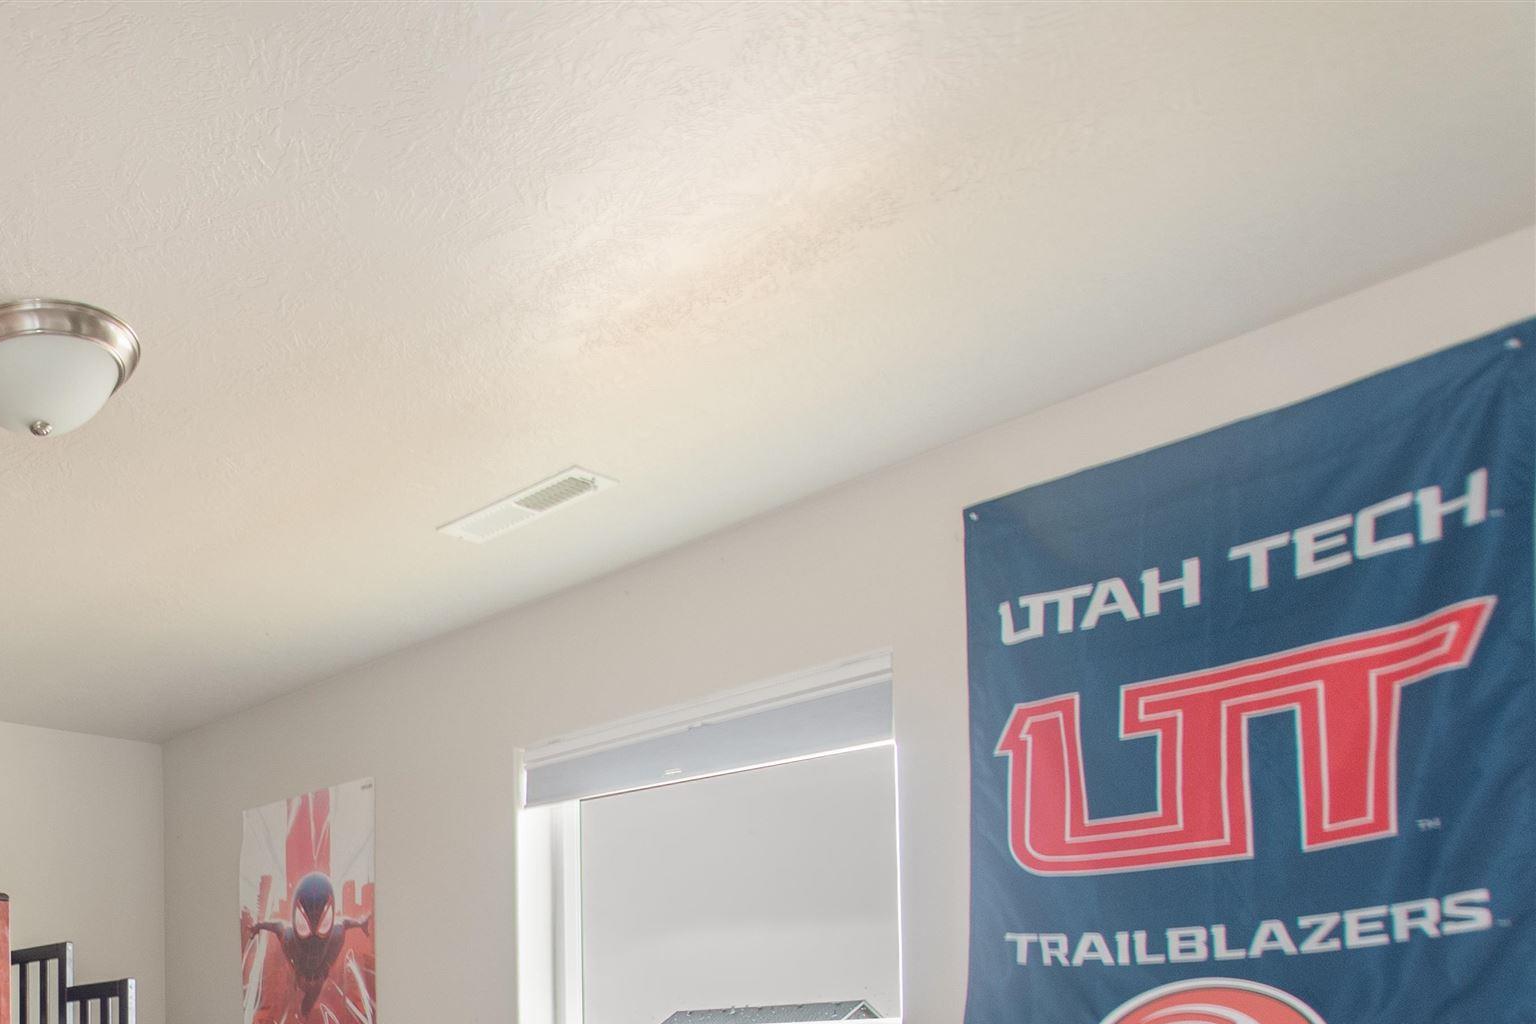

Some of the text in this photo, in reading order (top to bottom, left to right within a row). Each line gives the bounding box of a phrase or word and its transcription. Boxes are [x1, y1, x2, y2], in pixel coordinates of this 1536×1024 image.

[998, 467, 1488, 646] UTAH TECH
[1004, 888, 1493, 966] TRAILBLAZERS
